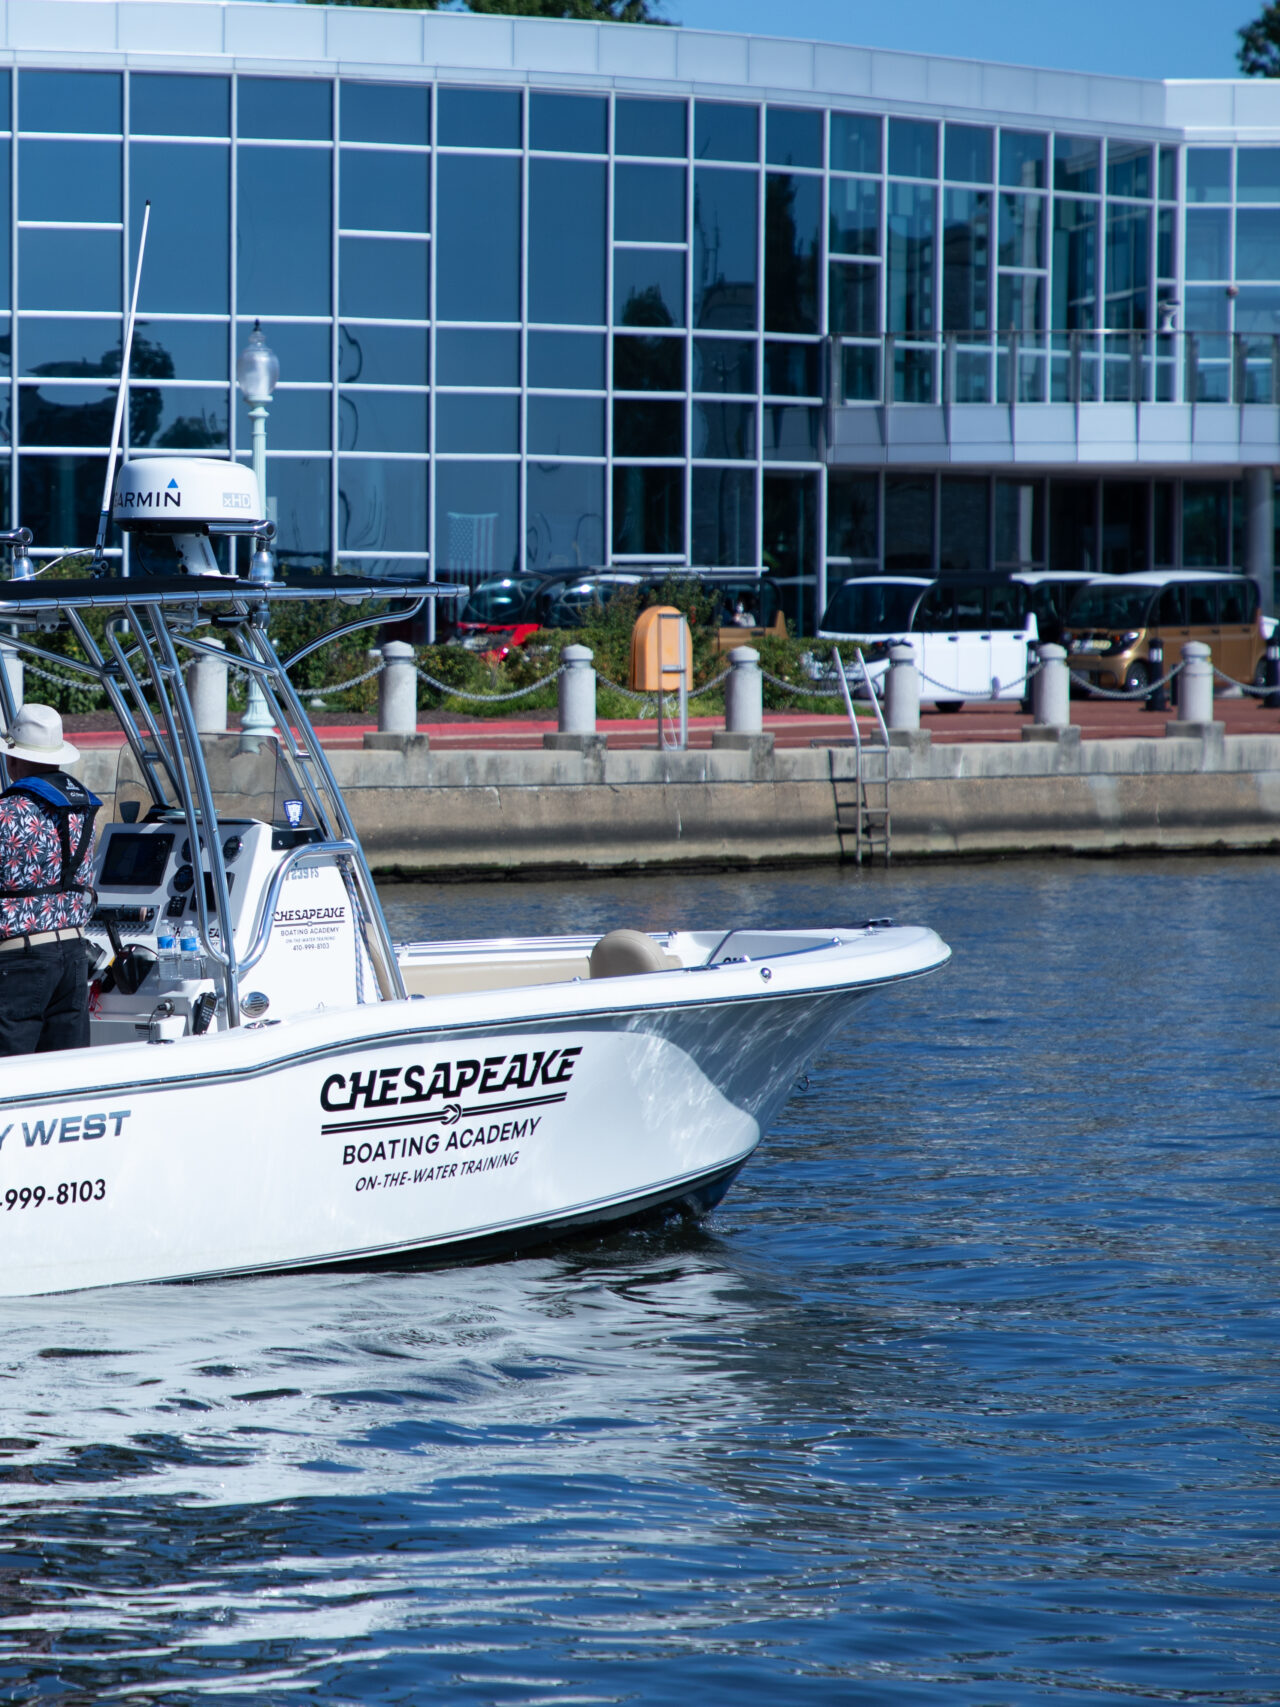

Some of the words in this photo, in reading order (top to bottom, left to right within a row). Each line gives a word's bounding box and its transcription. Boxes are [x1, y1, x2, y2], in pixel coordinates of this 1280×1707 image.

[223, 493, 251, 508] xHD
[274, 907, 345, 921] CHESAPEAKE
[292, 943, 329, 951] 410-999-8103
[320, 1046, 584, 1113] CHESAPEAKE
[21, 1110, 131, 1148] WEST
[342, 1134, 440, 1166] BOATING
[444, 1116, 542, 1151] ACADEMY
[355, 1163, 458, 1192] ON-THE-WATER
[460, 1151, 520, 1177] TRAINING
